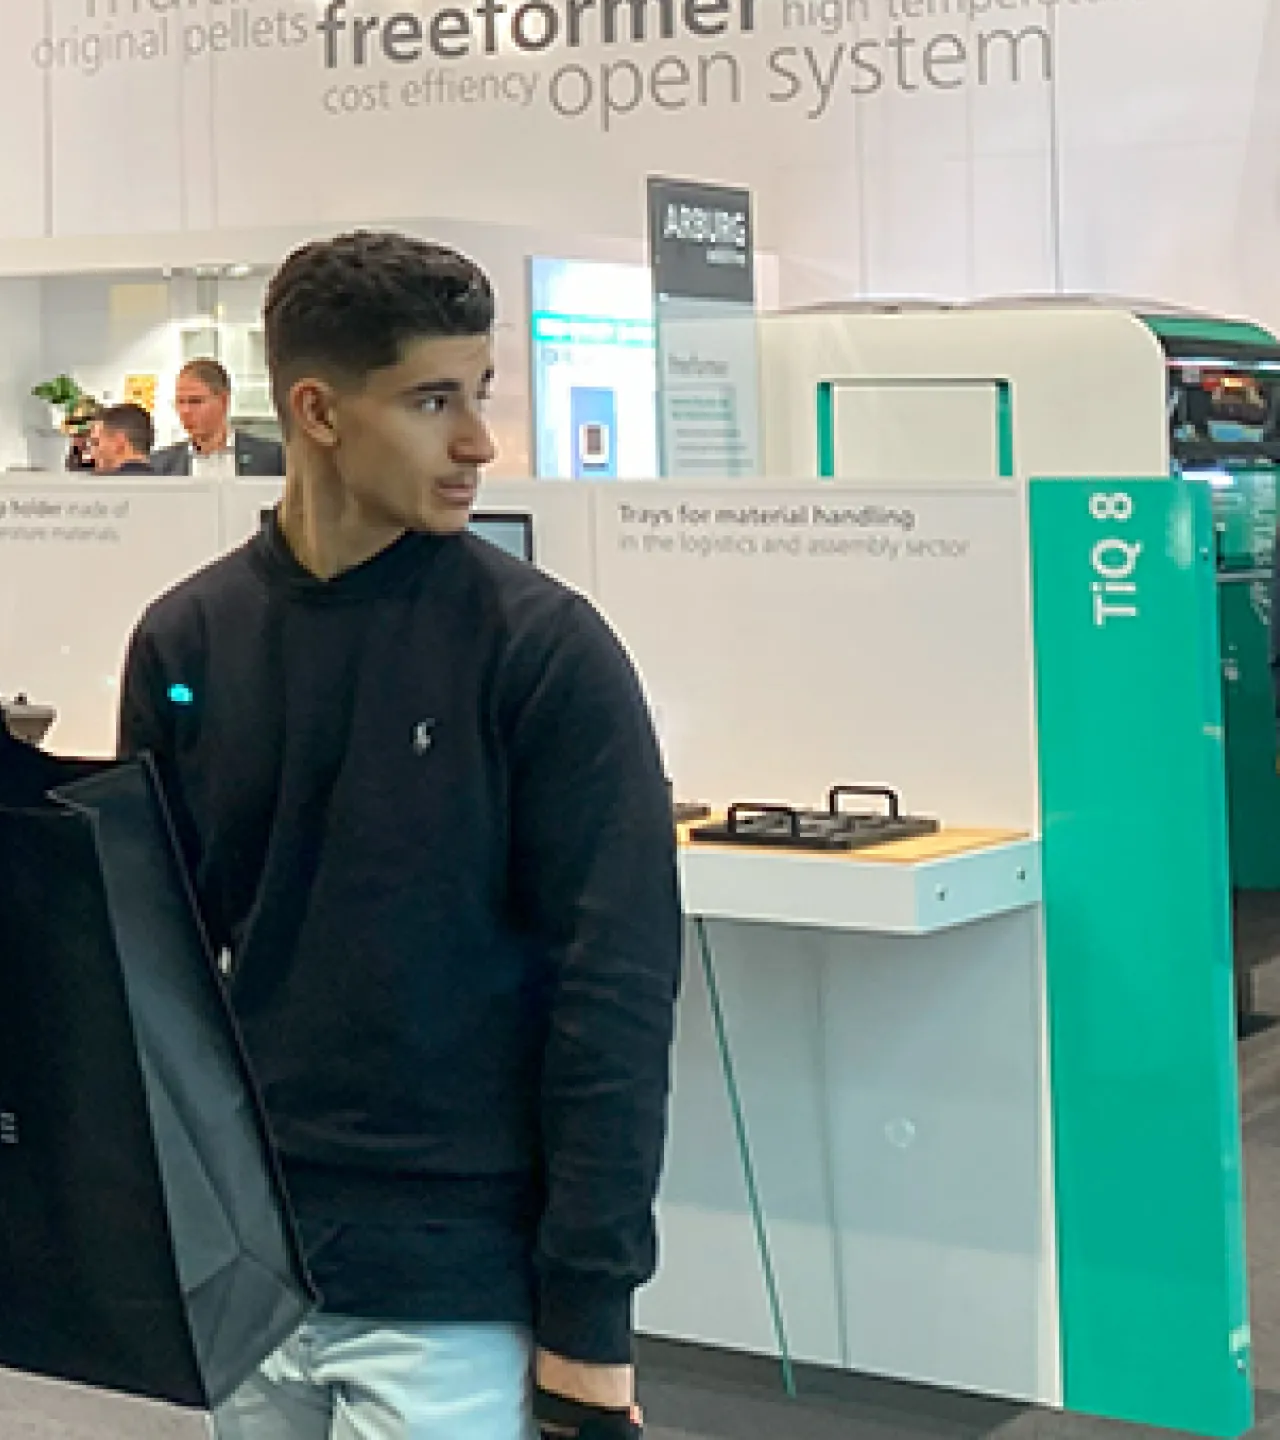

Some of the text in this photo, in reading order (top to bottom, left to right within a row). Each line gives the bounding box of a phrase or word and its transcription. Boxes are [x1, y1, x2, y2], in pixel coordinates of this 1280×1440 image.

[32, 8, 309, 77] original pellets
[323, 67, 541, 115] cost effiency
[547, 23, 1053, 132] open system
[618, 503, 916, 531] Trays for material handling
[641, 533, 675, 553] the
[762, 535, 802, 556] and
[807, 536, 901, 562] assembly
[905, 539, 972, 559] sector
[1088, 491, 1145, 628] TiQ 8
